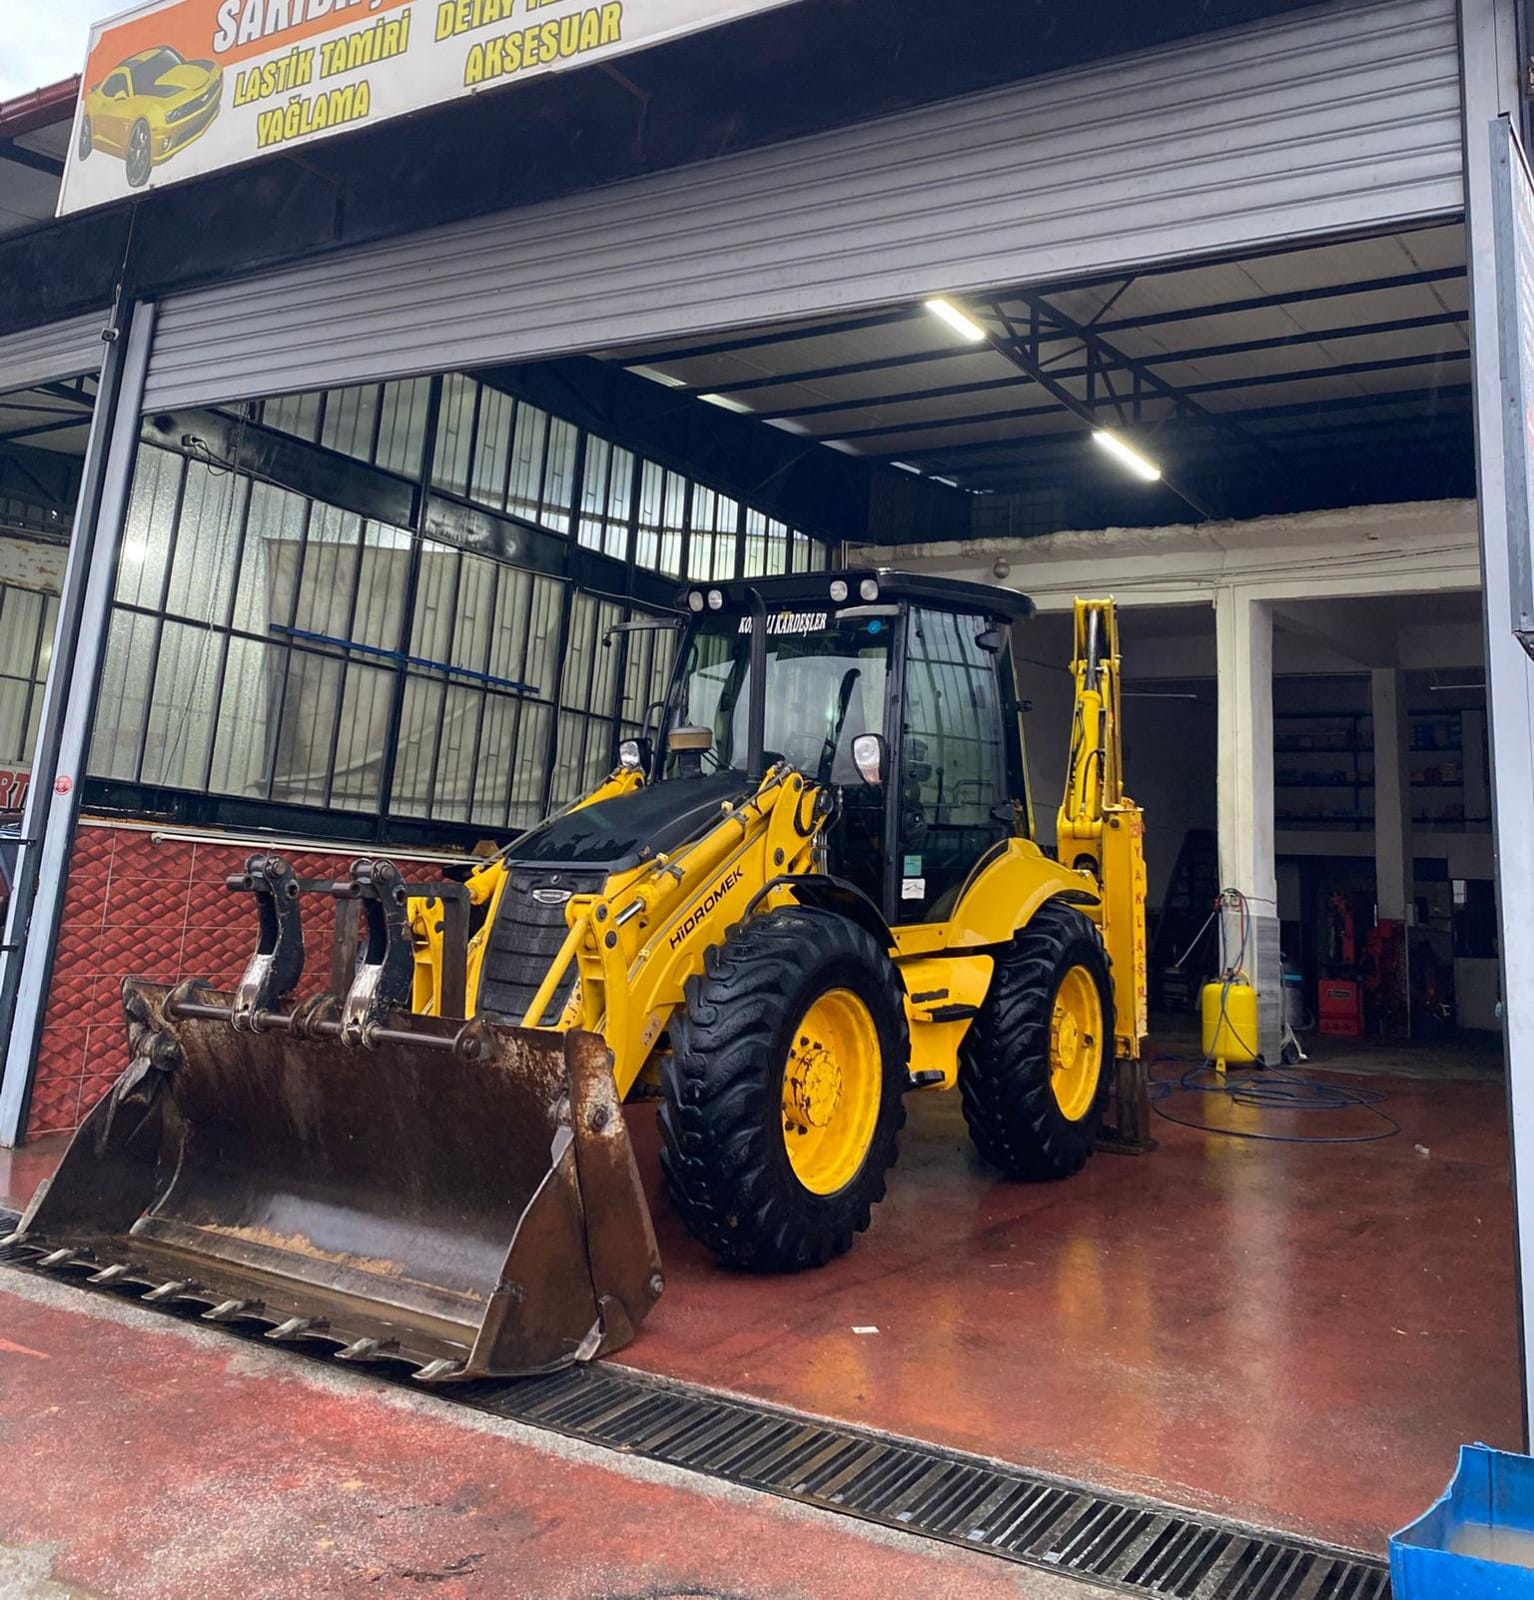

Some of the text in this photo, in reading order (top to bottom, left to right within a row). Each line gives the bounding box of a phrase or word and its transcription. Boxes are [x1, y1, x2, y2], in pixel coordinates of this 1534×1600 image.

[232, 8, 412, 108] LASTİK TAMİRİ
[464, 1, 622, 86] AKSESUAR
[257, 80, 370, 148] YAĞLAMA
[773, 613, 827, 637] KARDEŞLER
